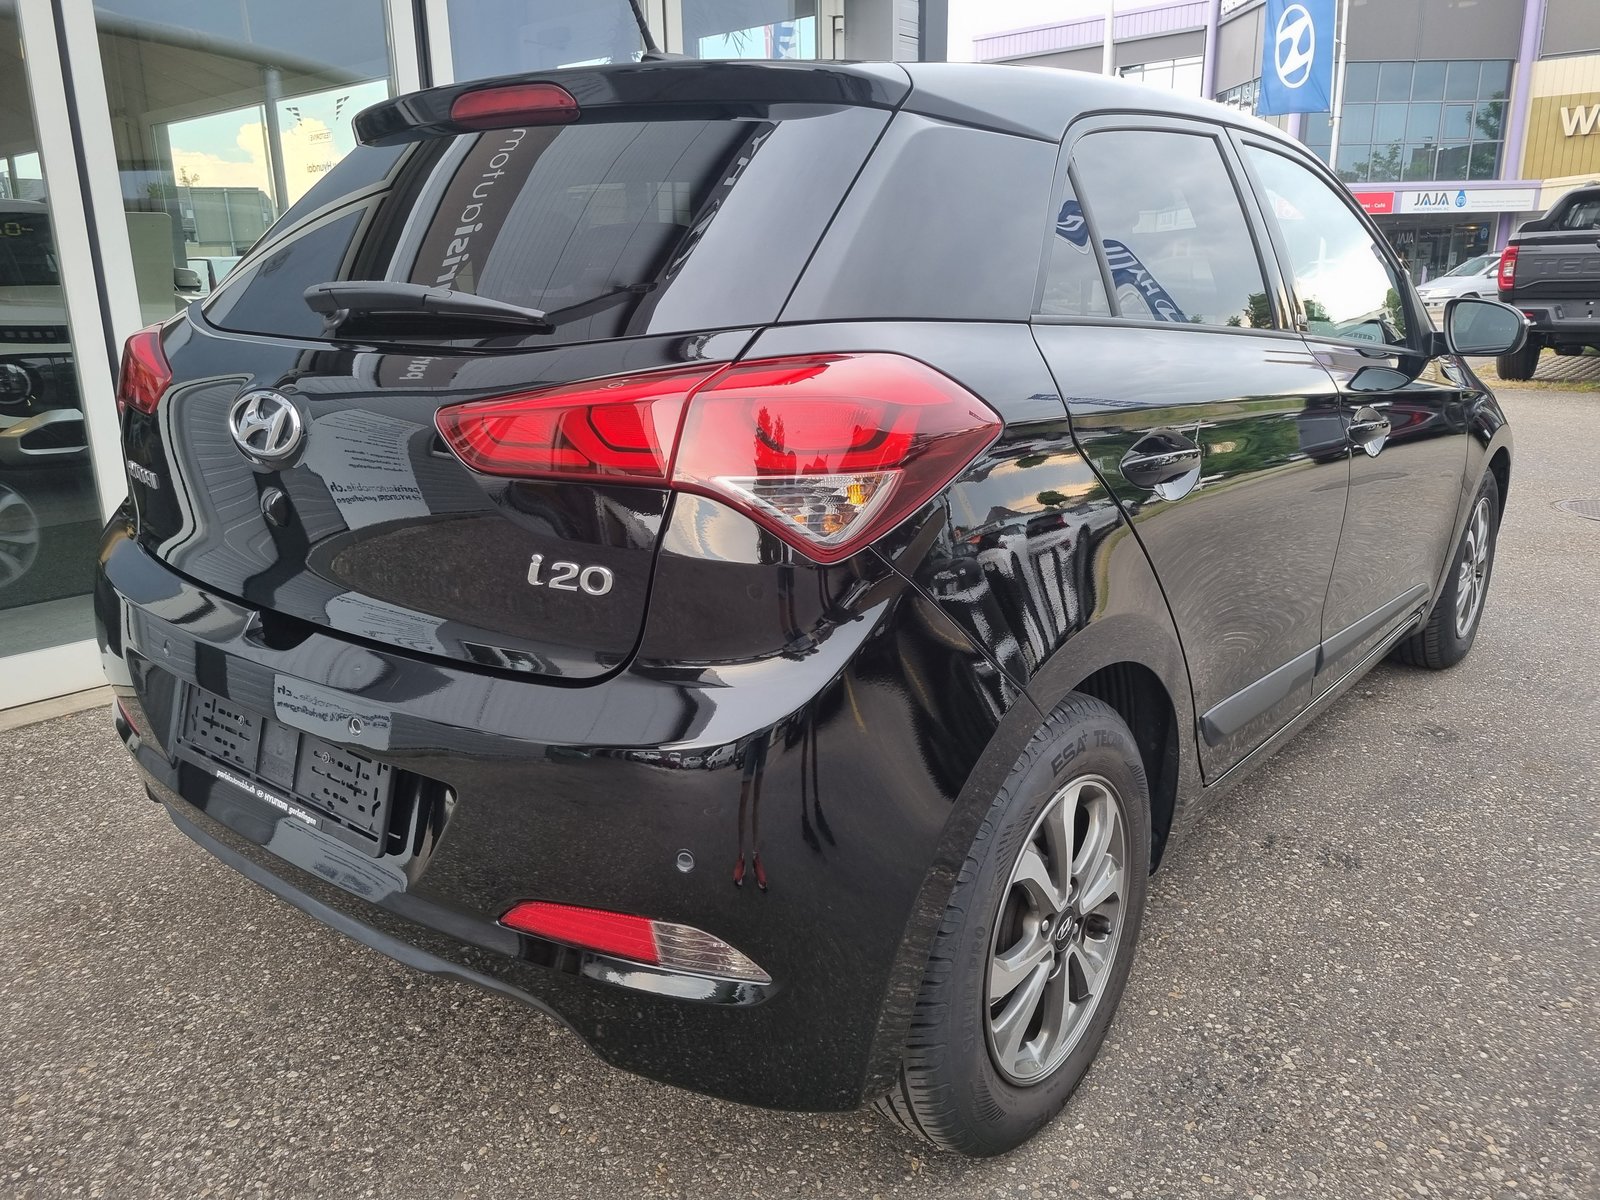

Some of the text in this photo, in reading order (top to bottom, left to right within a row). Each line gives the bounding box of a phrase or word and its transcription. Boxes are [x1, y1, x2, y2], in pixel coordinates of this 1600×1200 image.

[1414, 192, 1449, 206] JAJA
[527, 553, 614, 596] i20
[263, 792, 288, 811] HYUNDAI
